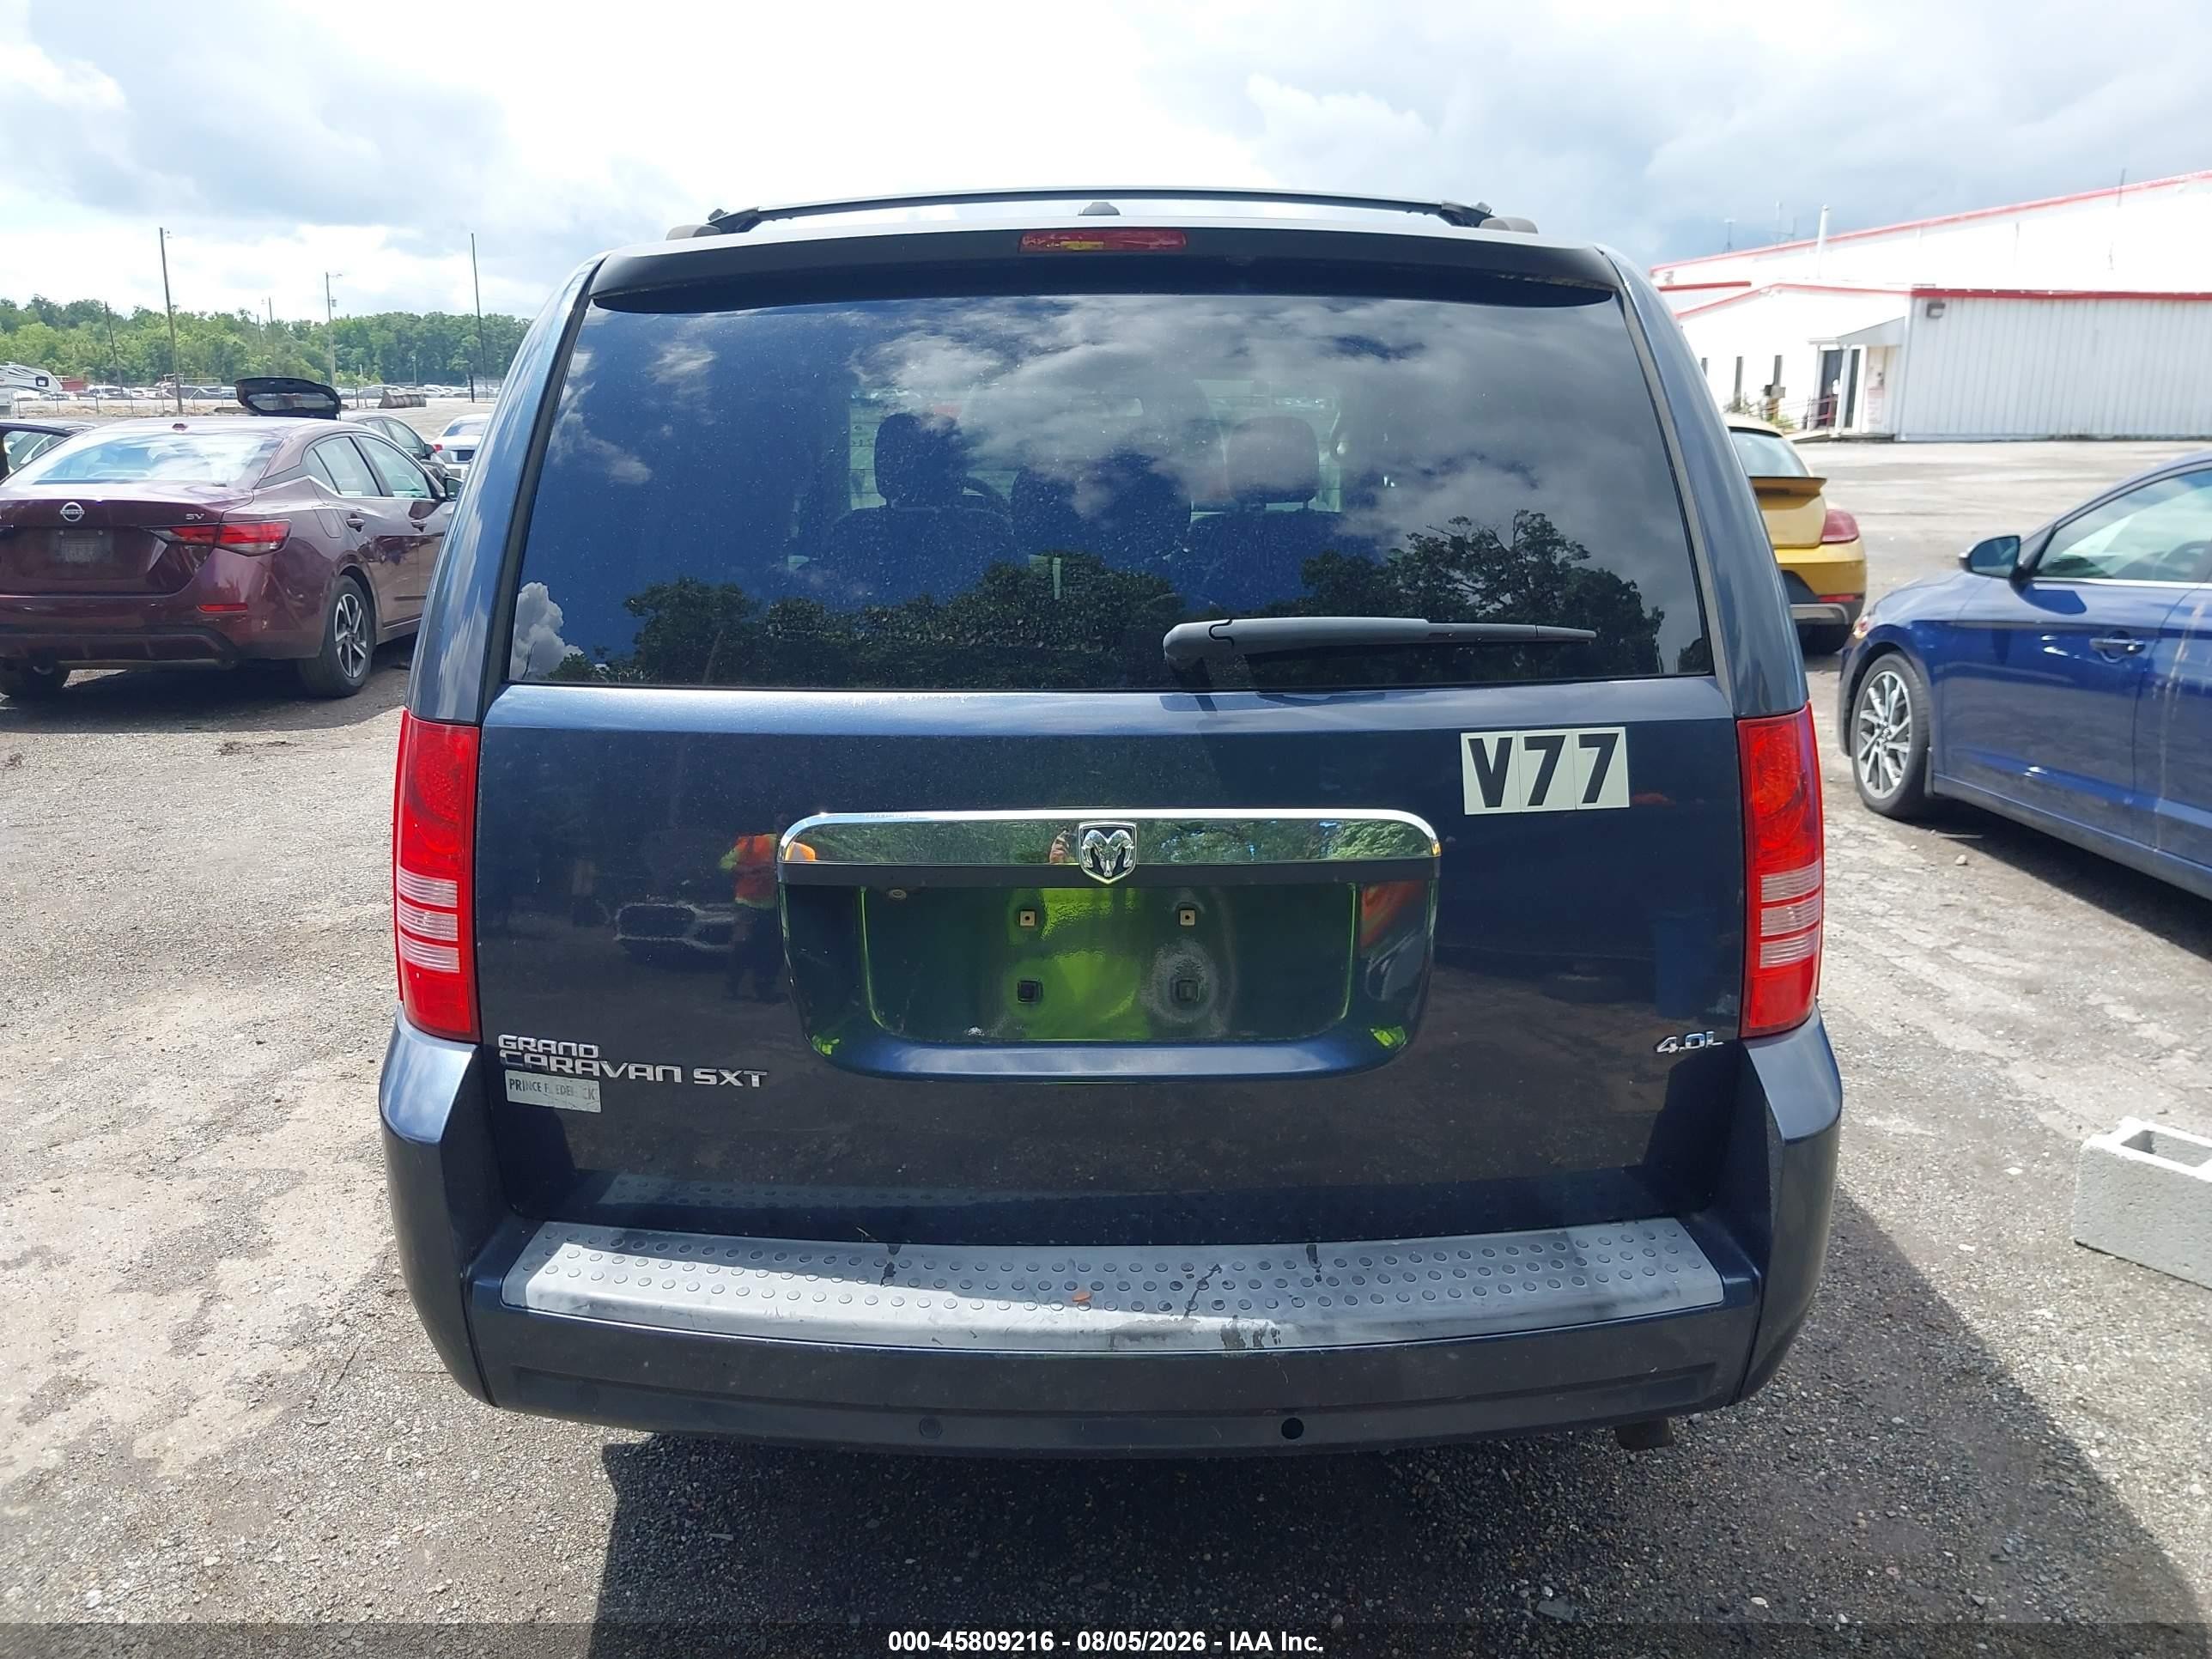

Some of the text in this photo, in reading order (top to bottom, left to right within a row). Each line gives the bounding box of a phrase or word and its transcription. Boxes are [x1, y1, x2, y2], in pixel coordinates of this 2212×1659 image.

[1467, 732, 1620, 809] V77
[497, 1033, 600, 1059] GRAND
[1656, 1030, 1725, 1054] 4.0L
[498, 1048, 769, 1088] CARAVAN SXT
[508, 1078, 543, 1093] PRINCE
